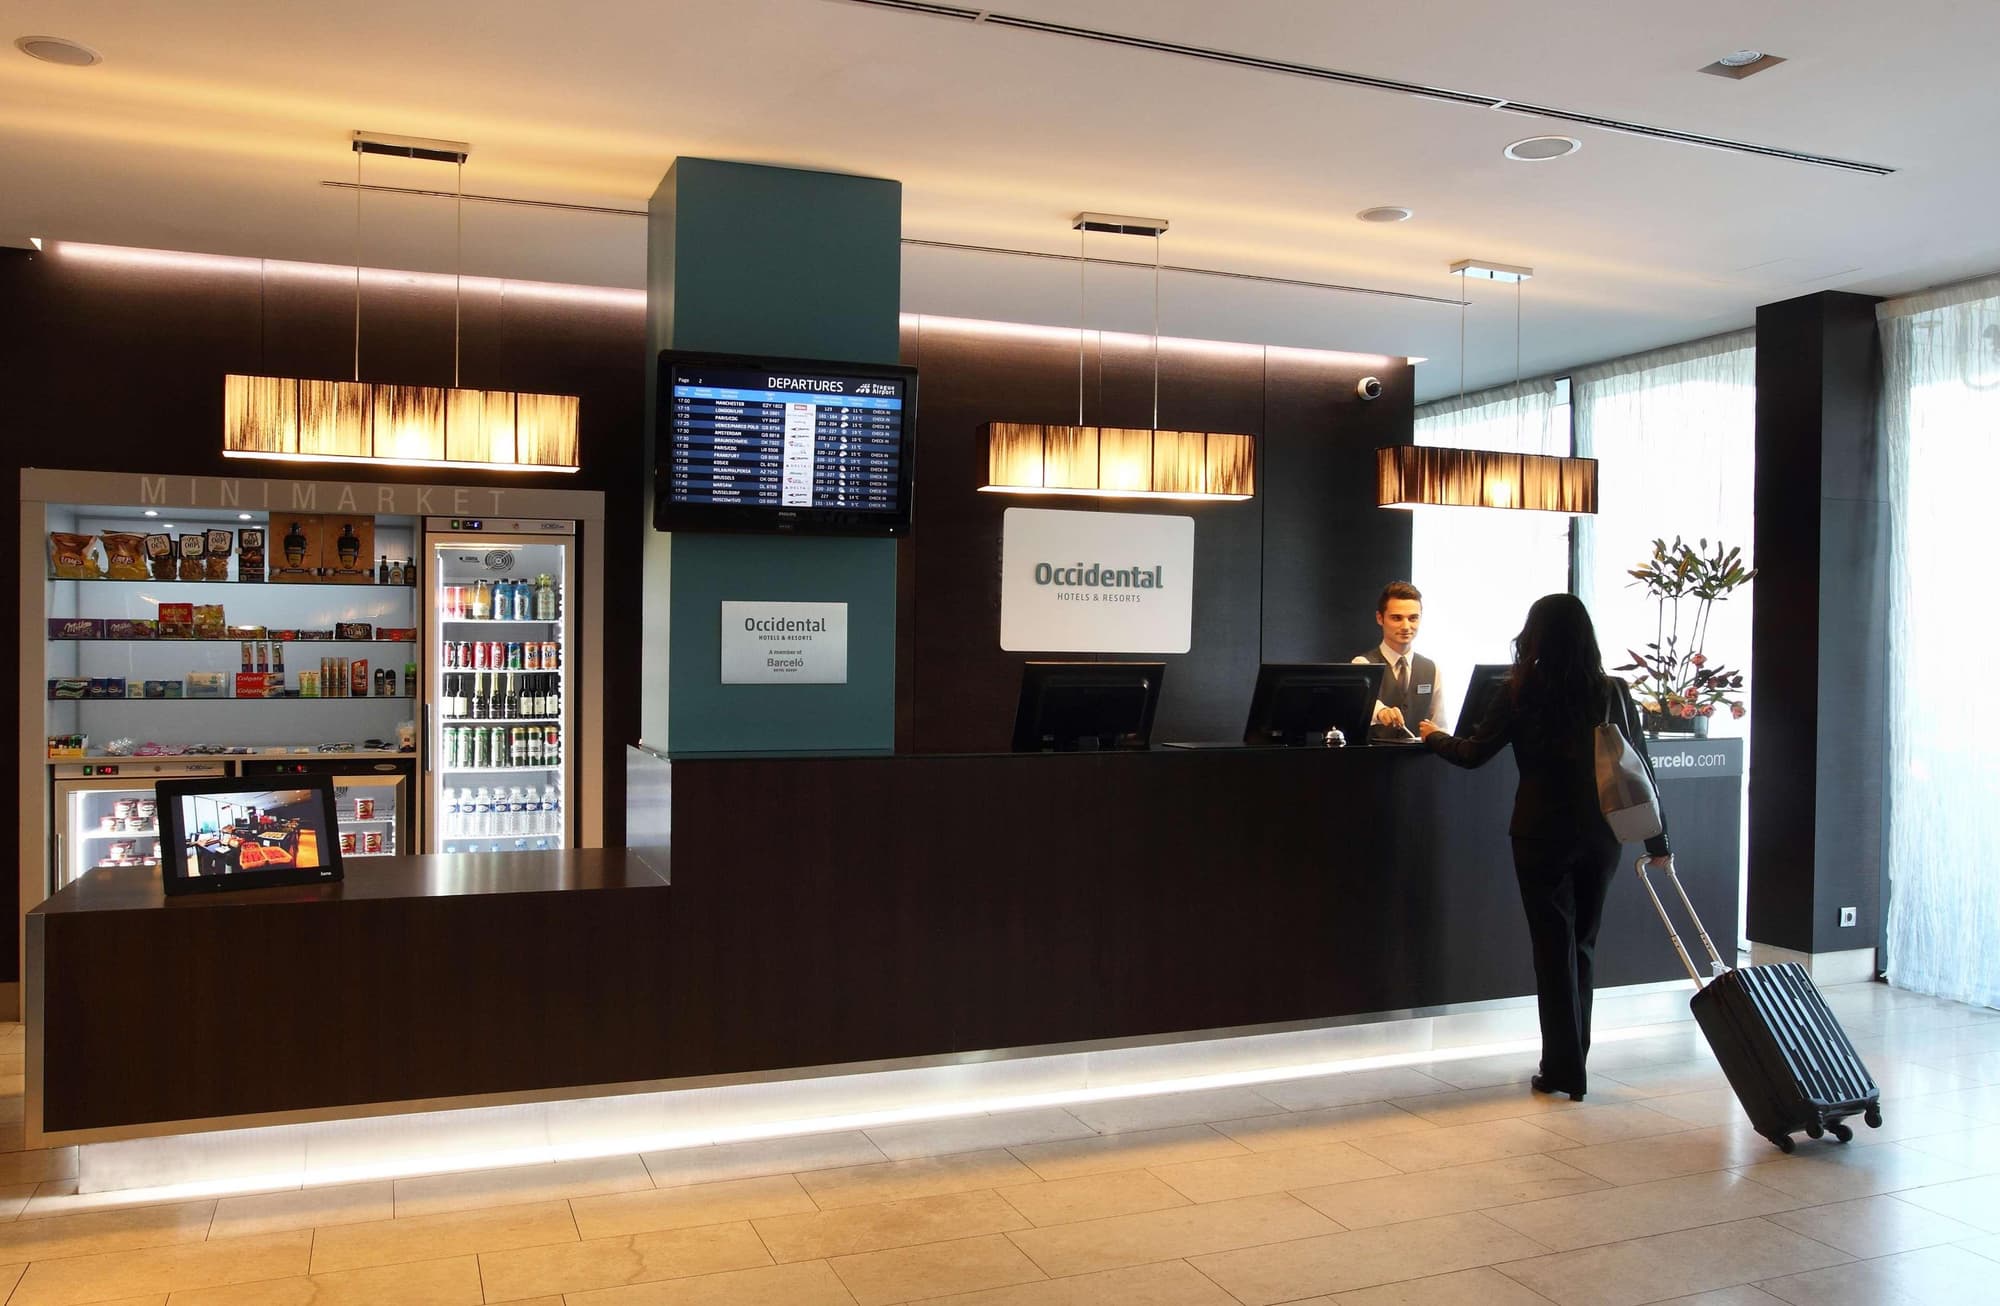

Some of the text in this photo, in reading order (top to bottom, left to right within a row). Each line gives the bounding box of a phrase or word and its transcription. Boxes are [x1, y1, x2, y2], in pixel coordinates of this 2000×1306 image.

[768, 377, 843, 392] DEPARTURES
[140, 476, 504, 516] MINIMARKET
[1035, 562, 1164, 589] Occidental
[1057, 592, 1090, 601] HOTELS
[1103, 594, 1141, 603] RESORTS
[745, 617, 826, 632] Occidental
[767, 658, 804, 667] Barceló
[1649, 752, 1726, 768] arcelo.com
